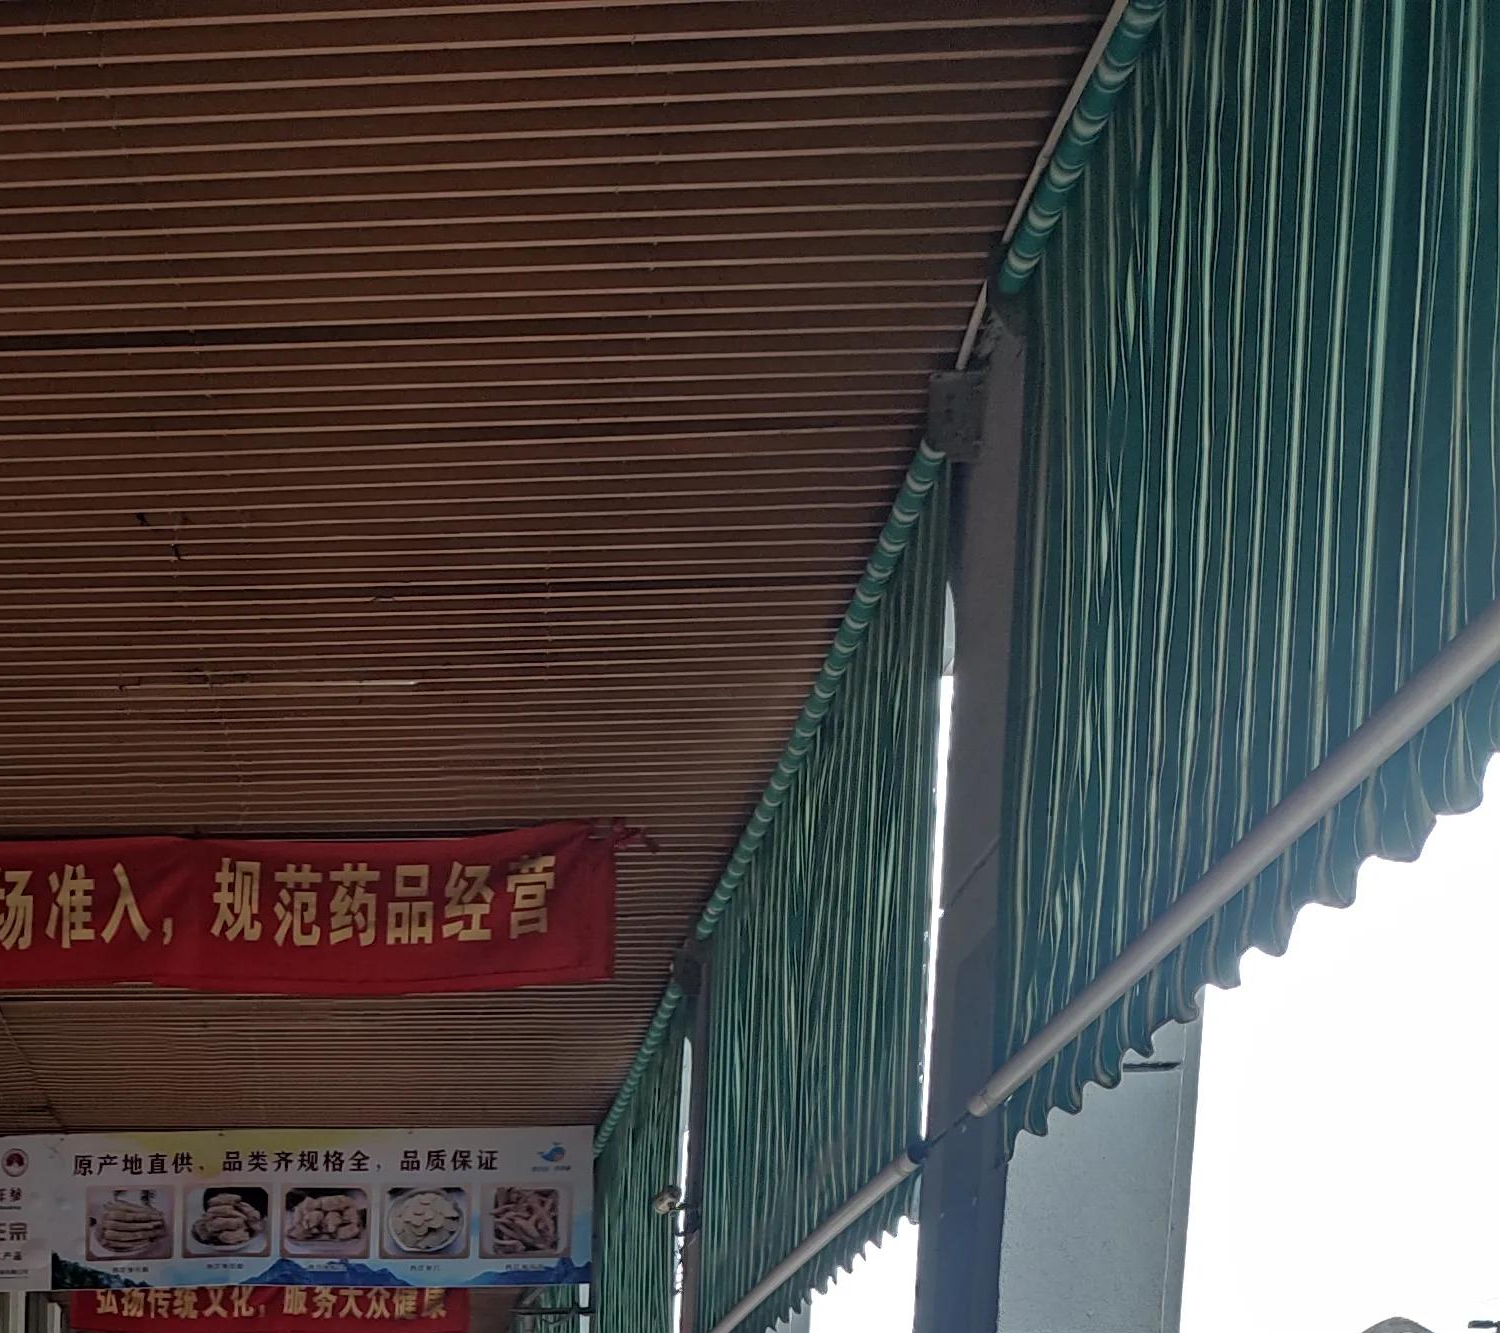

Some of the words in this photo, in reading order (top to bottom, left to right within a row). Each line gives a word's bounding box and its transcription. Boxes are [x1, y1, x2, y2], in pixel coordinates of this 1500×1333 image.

[96, 1286, 447, 1319] 弘扬传统文化，服务大众健康
